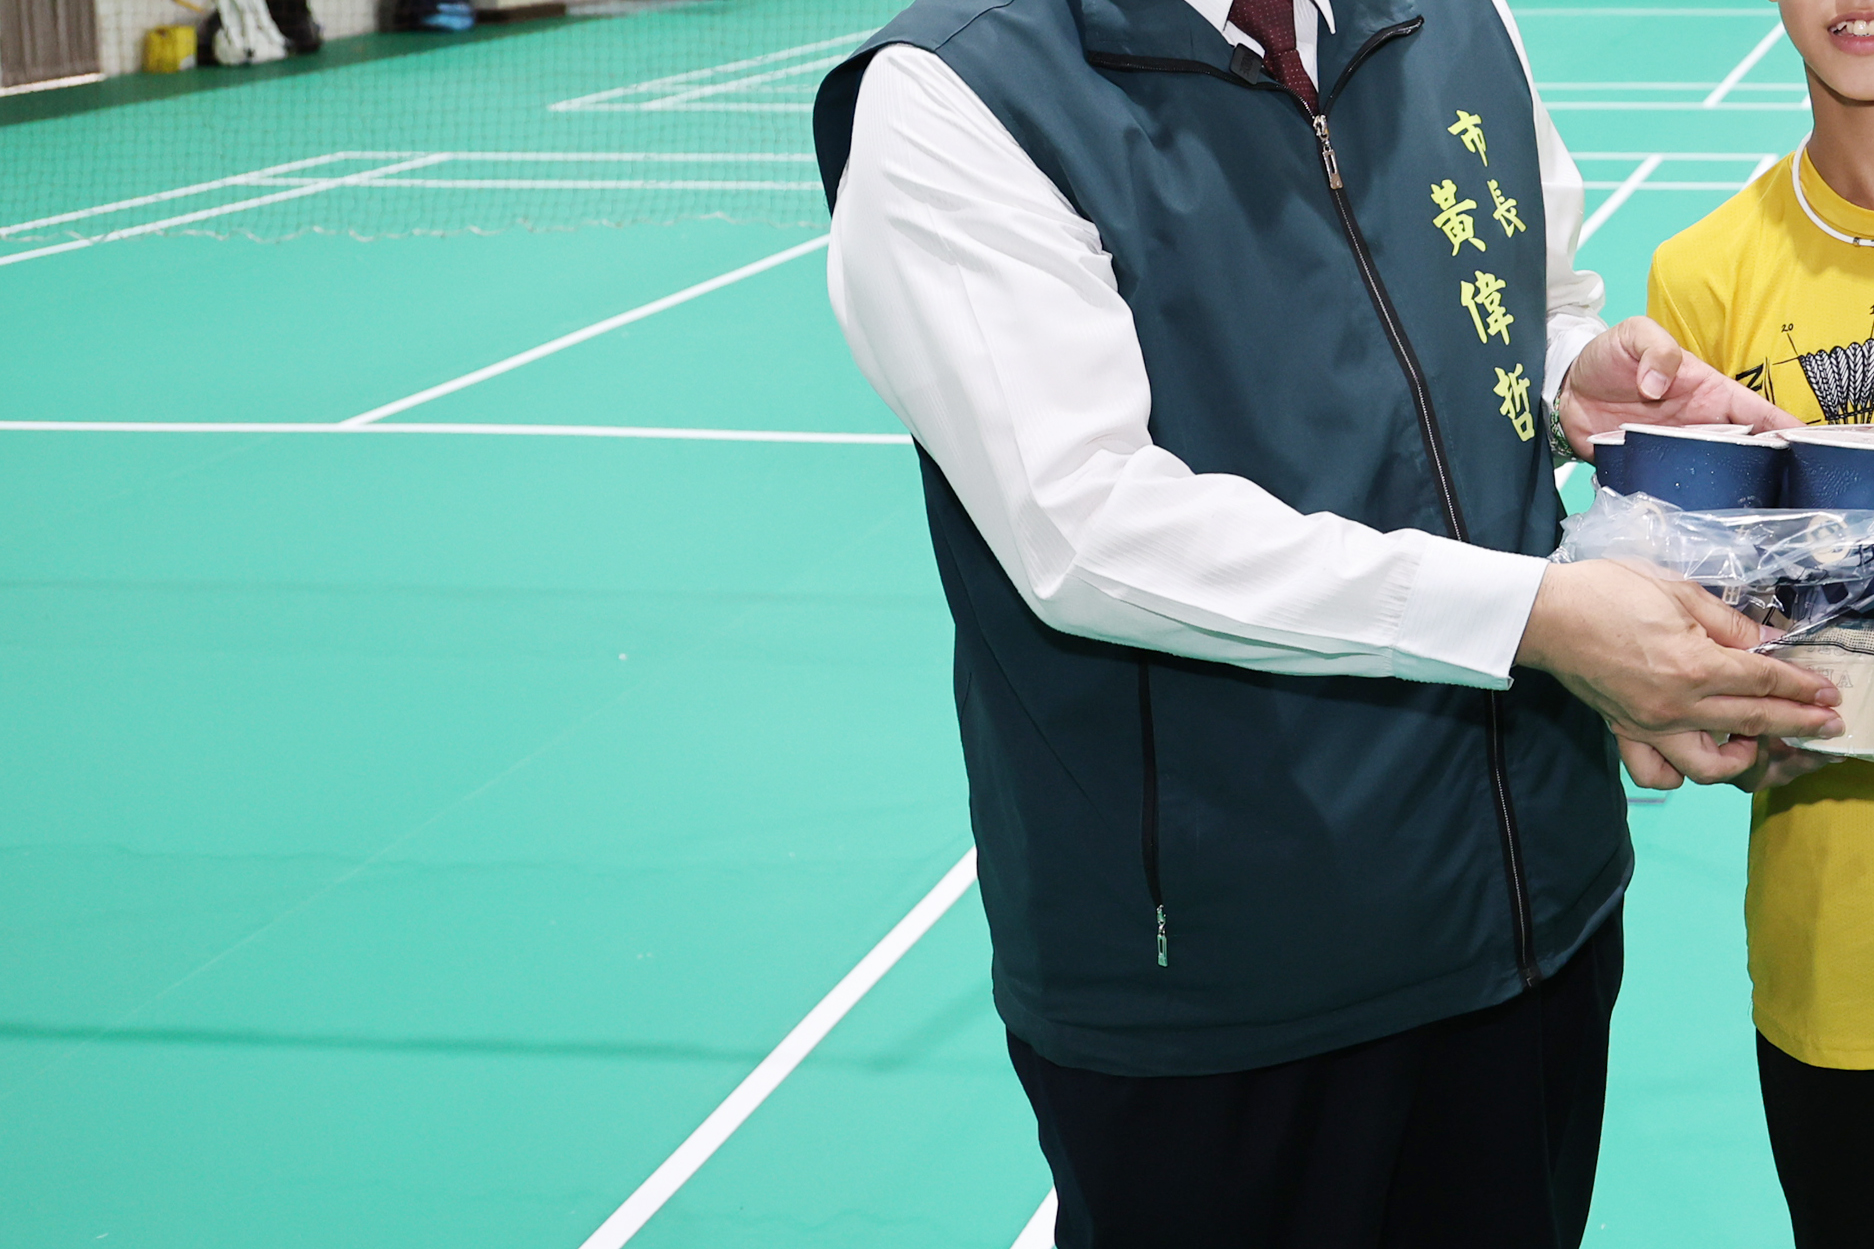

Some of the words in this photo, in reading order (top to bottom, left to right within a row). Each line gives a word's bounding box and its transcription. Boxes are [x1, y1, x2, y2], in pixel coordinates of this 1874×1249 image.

[1447, 109, 1527, 238] 市長
[1430, 178, 1536, 443] 黃偉哲
[1781, 323, 1794, 333] 20
